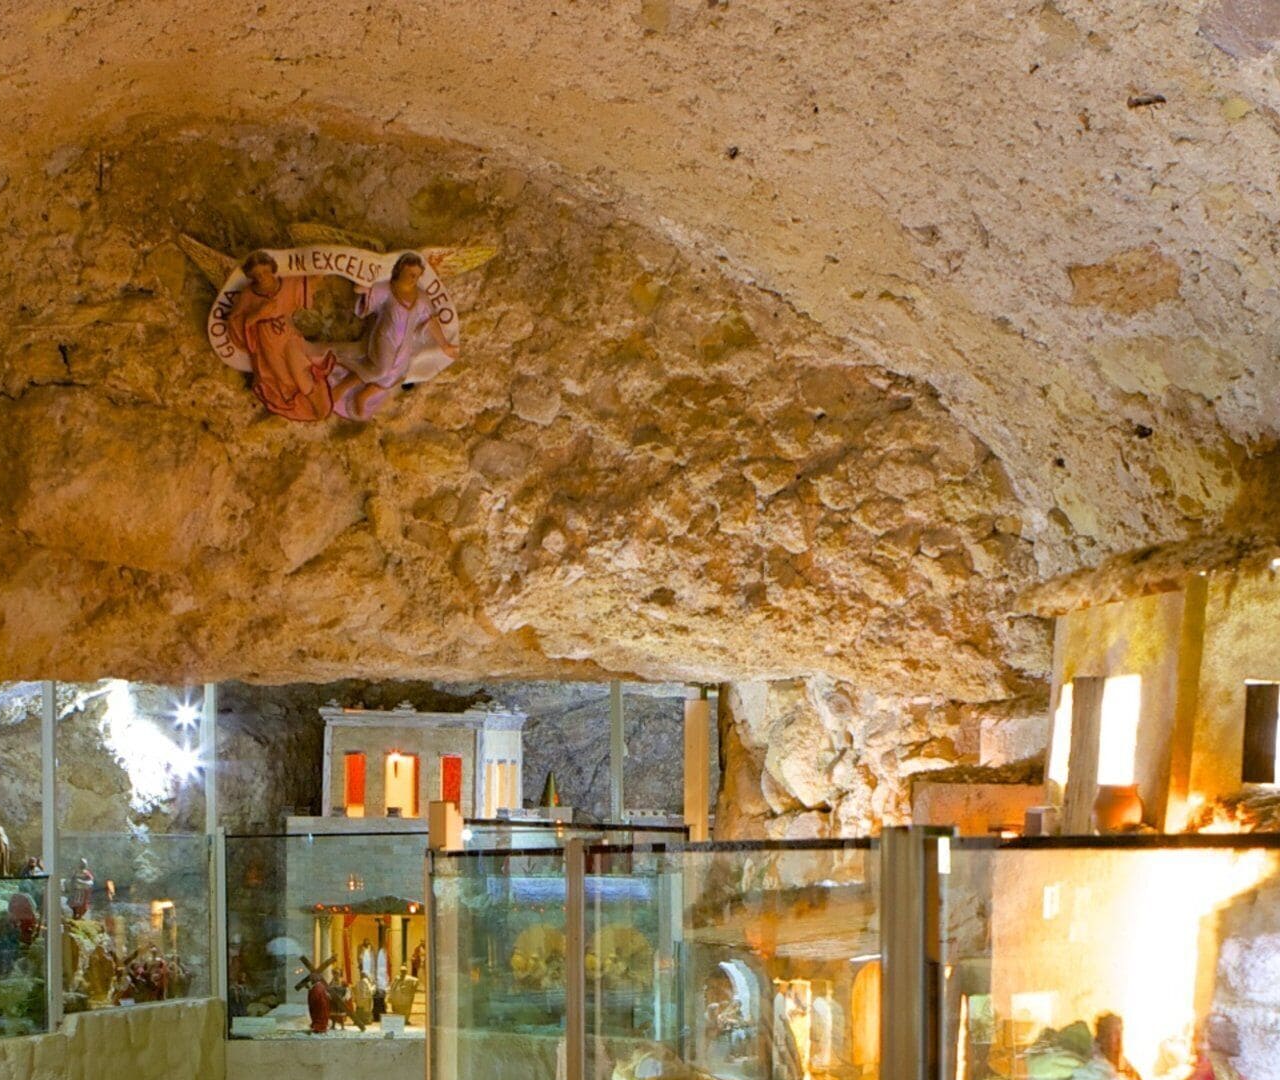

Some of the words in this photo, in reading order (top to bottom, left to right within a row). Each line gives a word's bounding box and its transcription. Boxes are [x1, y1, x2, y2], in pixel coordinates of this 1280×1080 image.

[211, 291, 240, 358] GLORIA
[288, 254, 307, 272] IN
[426, 279, 454, 324] DEO
